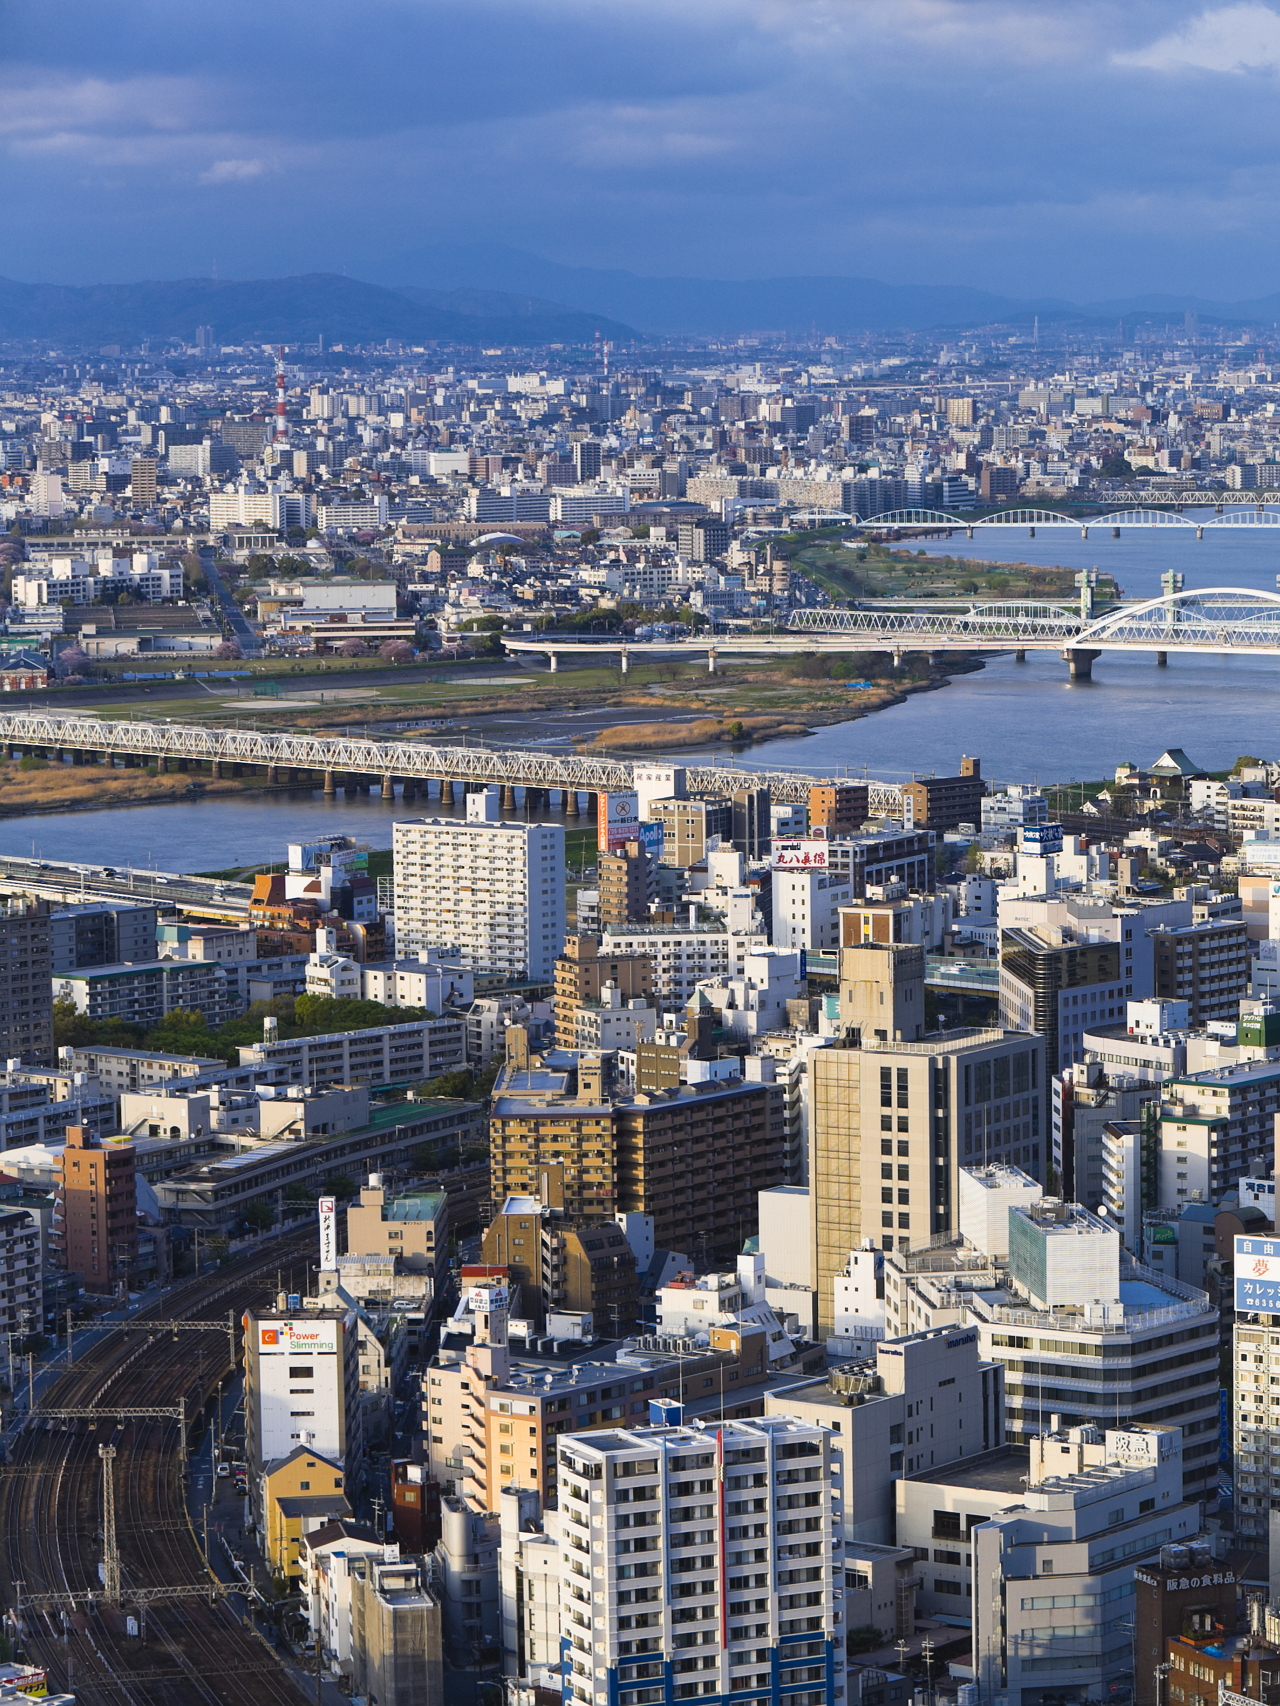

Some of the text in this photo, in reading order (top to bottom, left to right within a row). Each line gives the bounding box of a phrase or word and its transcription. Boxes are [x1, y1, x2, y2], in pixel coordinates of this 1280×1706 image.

[636, 773, 671, 781] 尾家産業
[289, 1331, 320, 1340] Power
[947, 1333, 976, 1349] maruho
[290, 1340, 334, 1350] Slimming
[1115, 1435, 1150, 1454] 阪急
[1166, 1571, 1235, 1591] 阪急の食料品
